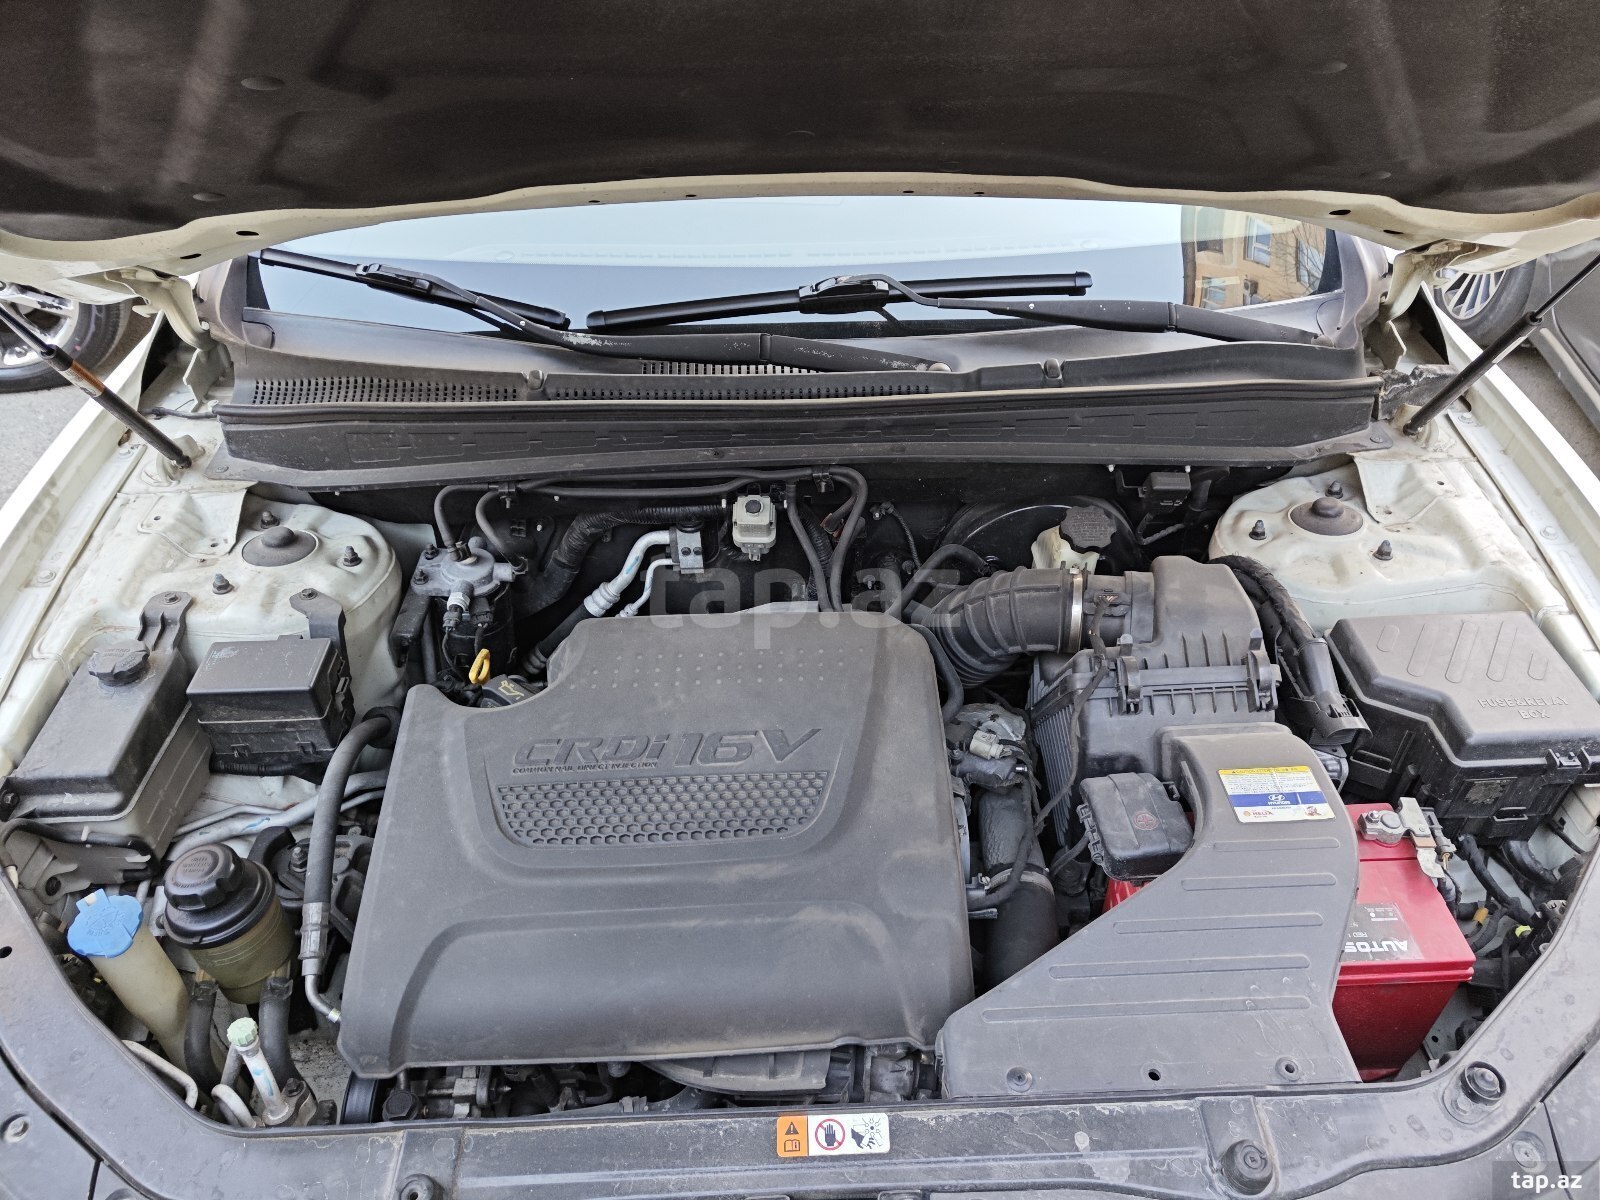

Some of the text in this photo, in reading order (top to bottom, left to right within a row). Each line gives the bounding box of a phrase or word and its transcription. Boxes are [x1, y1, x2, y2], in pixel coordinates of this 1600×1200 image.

[1518, 709, 1551, 719] BOX
[514, 728, 824, 767] CRDi 16V
